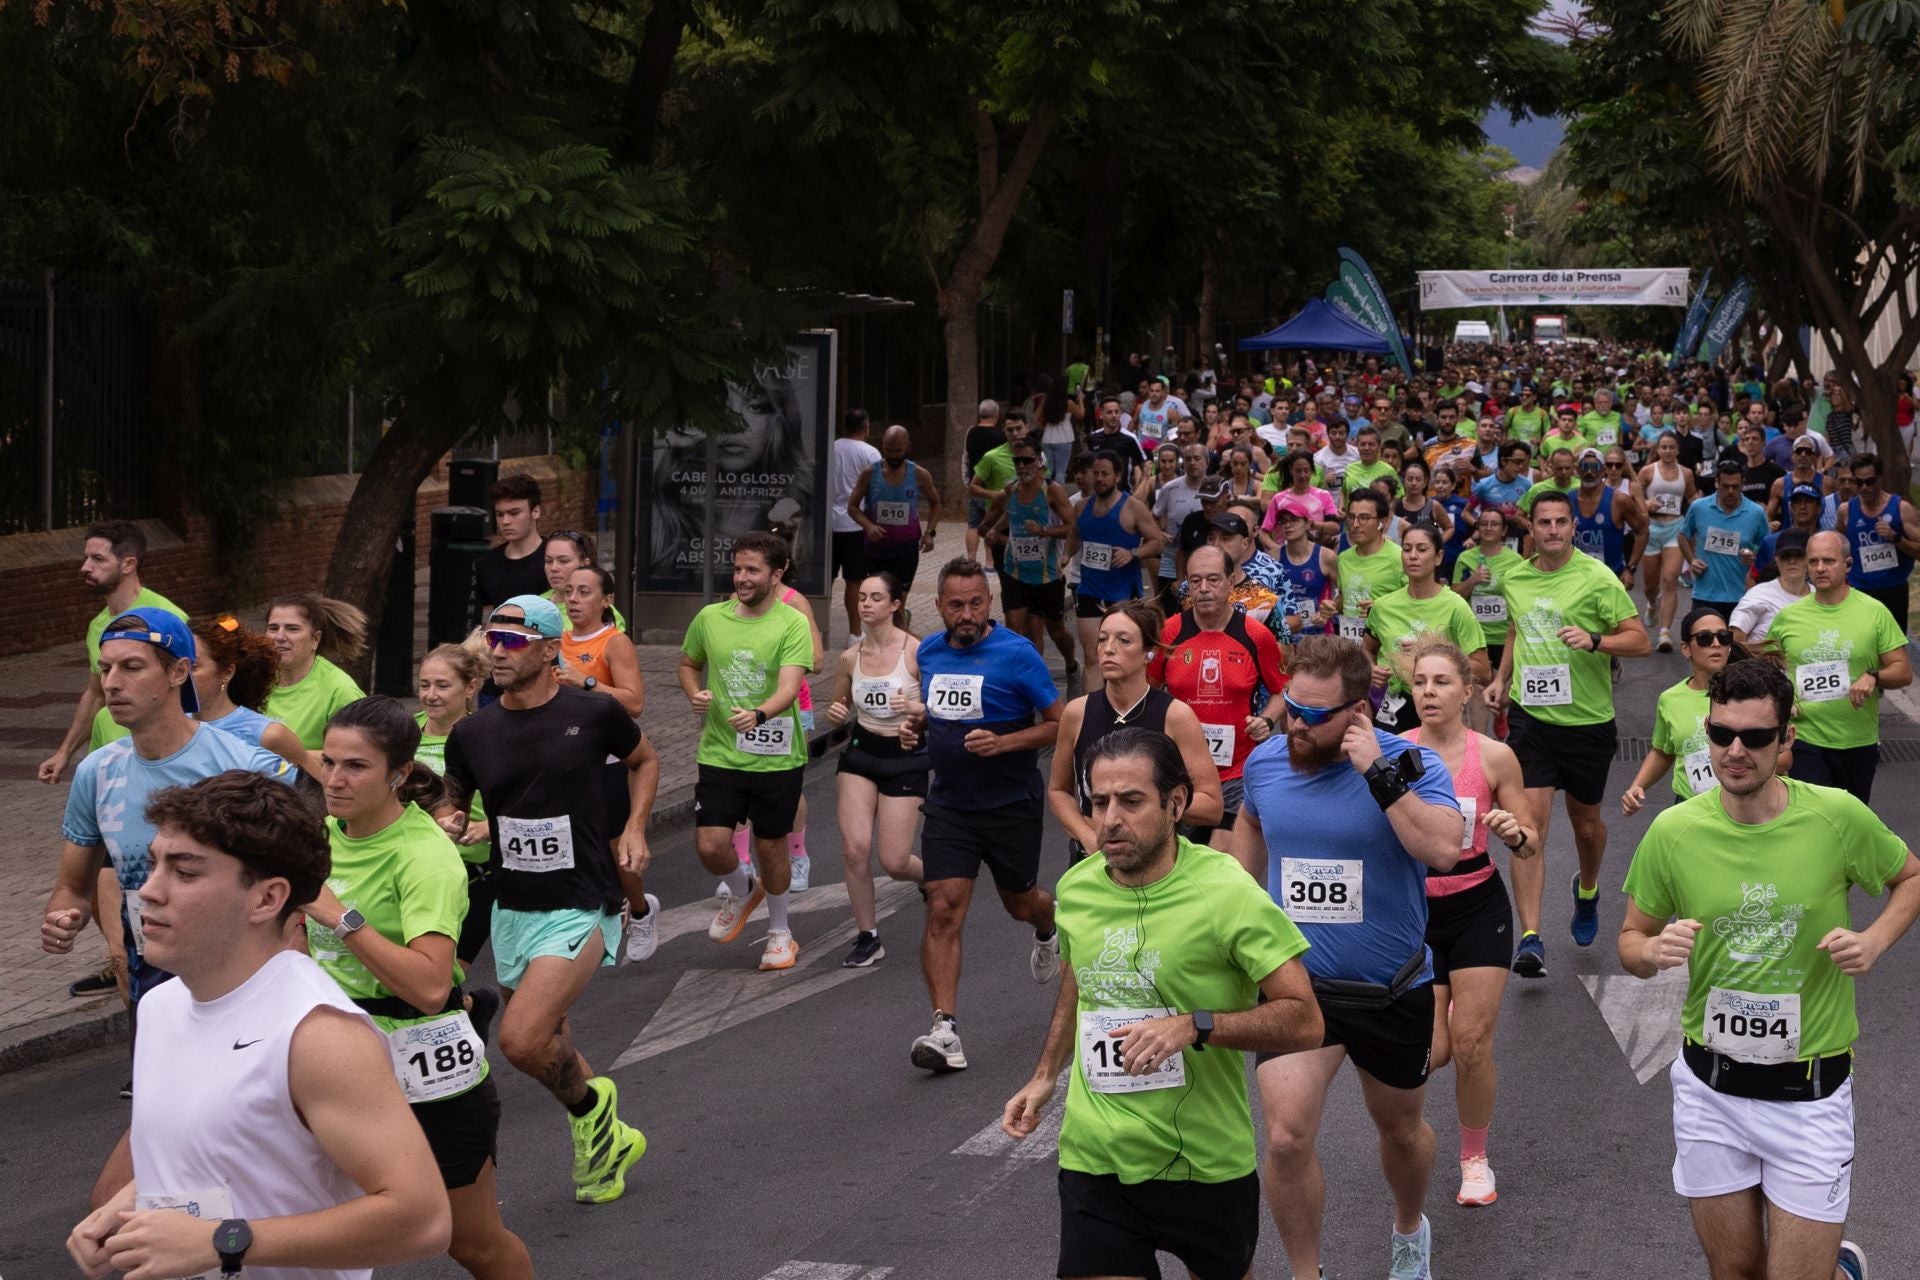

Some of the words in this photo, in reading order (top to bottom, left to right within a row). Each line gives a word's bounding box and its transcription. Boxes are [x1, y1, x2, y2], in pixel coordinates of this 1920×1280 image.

[1489, 272, 1538, 283] Carrera
[1542, 272, 1559, 282] de
[1562, 272, 1573, 282] la
[1577, 272, 1622, 282] Prensa
[671, 471, 737, 484] CABELO
[740, 473, 796, 485] GLOSSY
[680, 486, 687, 495] 4
[689, 484, 709, 495] DÍA
[720, 487, 783, 497] ANTI-FRIZZ
[881, 508, 904, 519] 610
[1711, 535, 1734, 548] 715
[1016, 545, 1040, 555] 124
[1085, 550, 1107, 562] 523
[1864, 551, 1893, 563] 1044
[1476, 604, 1500, 614] 890
[1526, 678, 1561, 694] 621
[1803, 675, 1841, 692] 226
[864, 692, 887, 706] 40
[935, 690, 972, 707] 706
[744, 729, 784, 744] 653
[508, 836, 559, 857] 416
[1290, 880, 1347, 904] 308
[1712, 1013, 1789, 1039] 1094
[408, 1039, 475, 1077] 188
